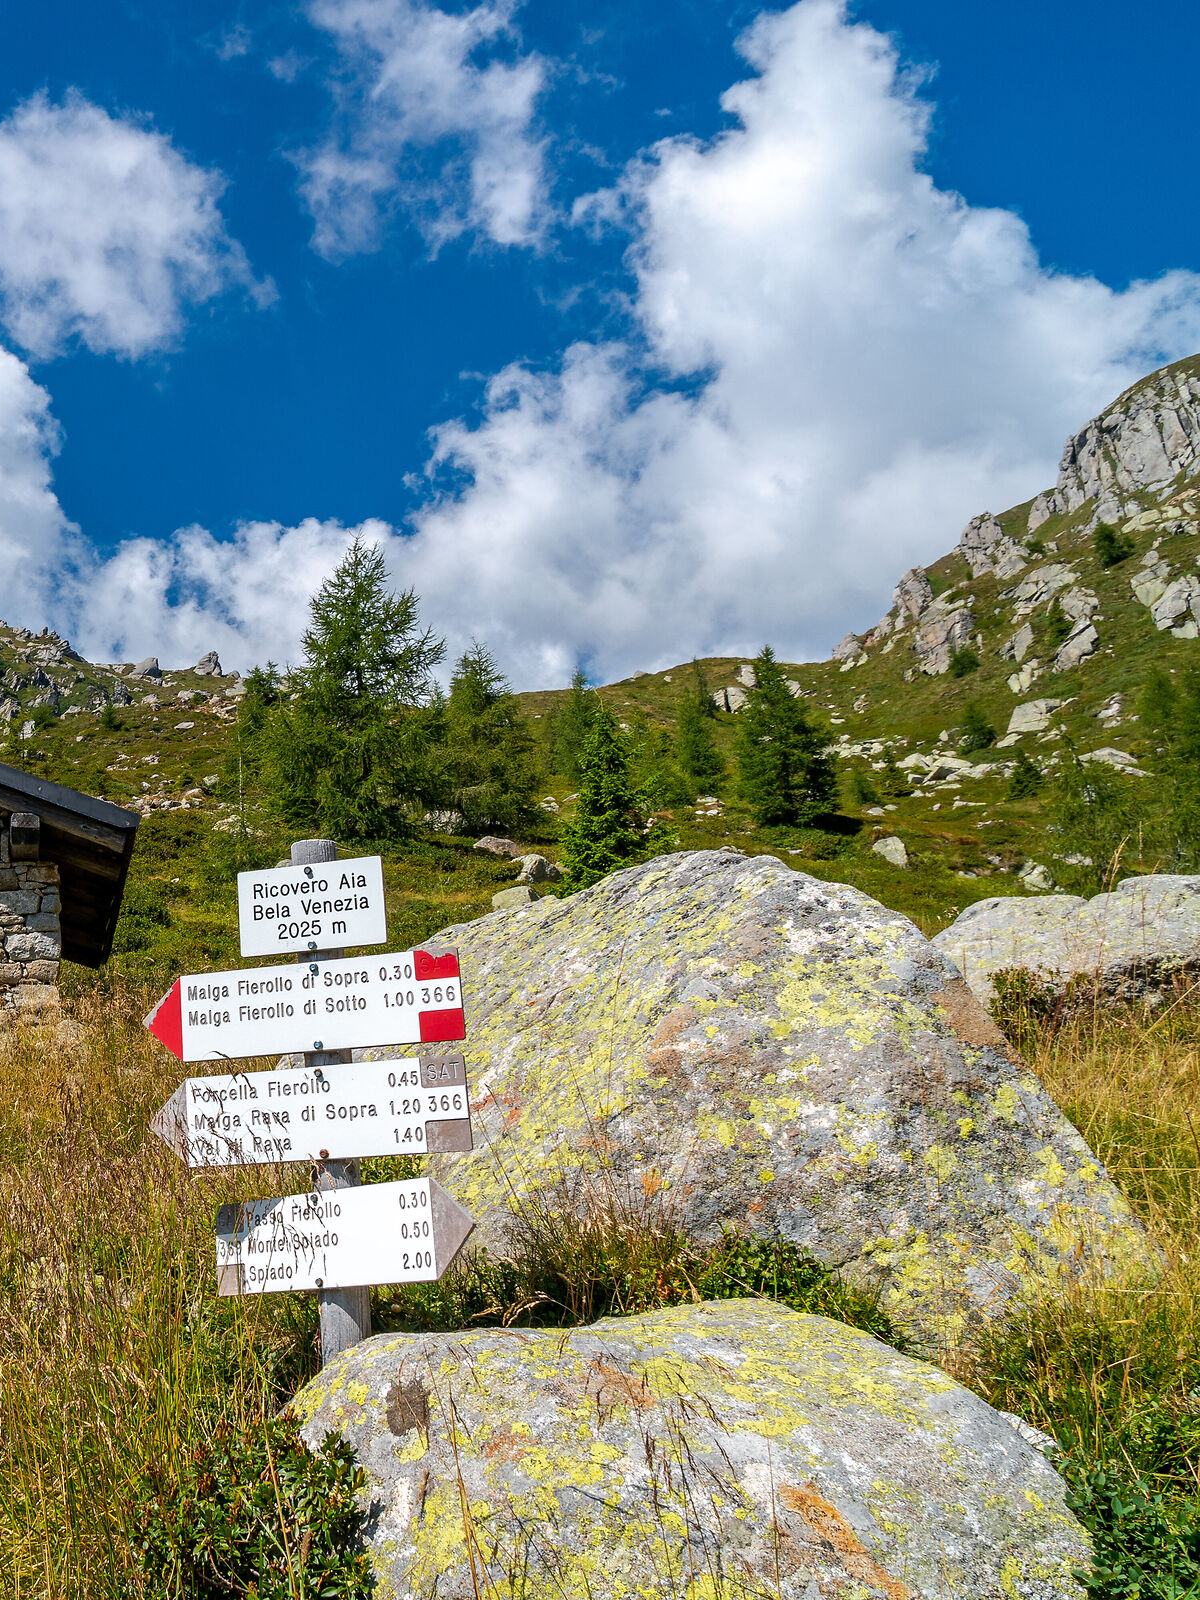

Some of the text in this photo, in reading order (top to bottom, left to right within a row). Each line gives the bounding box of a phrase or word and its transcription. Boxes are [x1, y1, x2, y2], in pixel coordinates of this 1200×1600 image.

[253, 872, 367, 900] Ricovero Aia
[253, 894, 370, 921] Bela Venezia
[277, 919, 347, 940] 2025 m
[187, 964, 413, 1002] Malga Fierollo di Sopra 0.30
[421, 985, 456, 1004] 366
[188, 990, 415, 1028] Malga Fierollo di Sotto 1.00
[426, 1061, 459, 1081] SAT
[192, 1070, 418, 1104] Forcella Fierollo 0.45
[194, 1112, 242, 1131] Malga
[301, 1105, 316, 1122] di
[325, 1103, 378, 1122] Sopra
[389, 1098, 421, 1116] 1.20
[428, 1093, 462, 1113] 366
[393, 1126, 424, 1144] 1.40
[291, 1201, 342, 1222] Fierollo
[399, 1190, 427, 1210] 0.30
[401, 1220, 430, 1240] 0.50
[249, 1251, 432, 1285] Spiado 2.00
